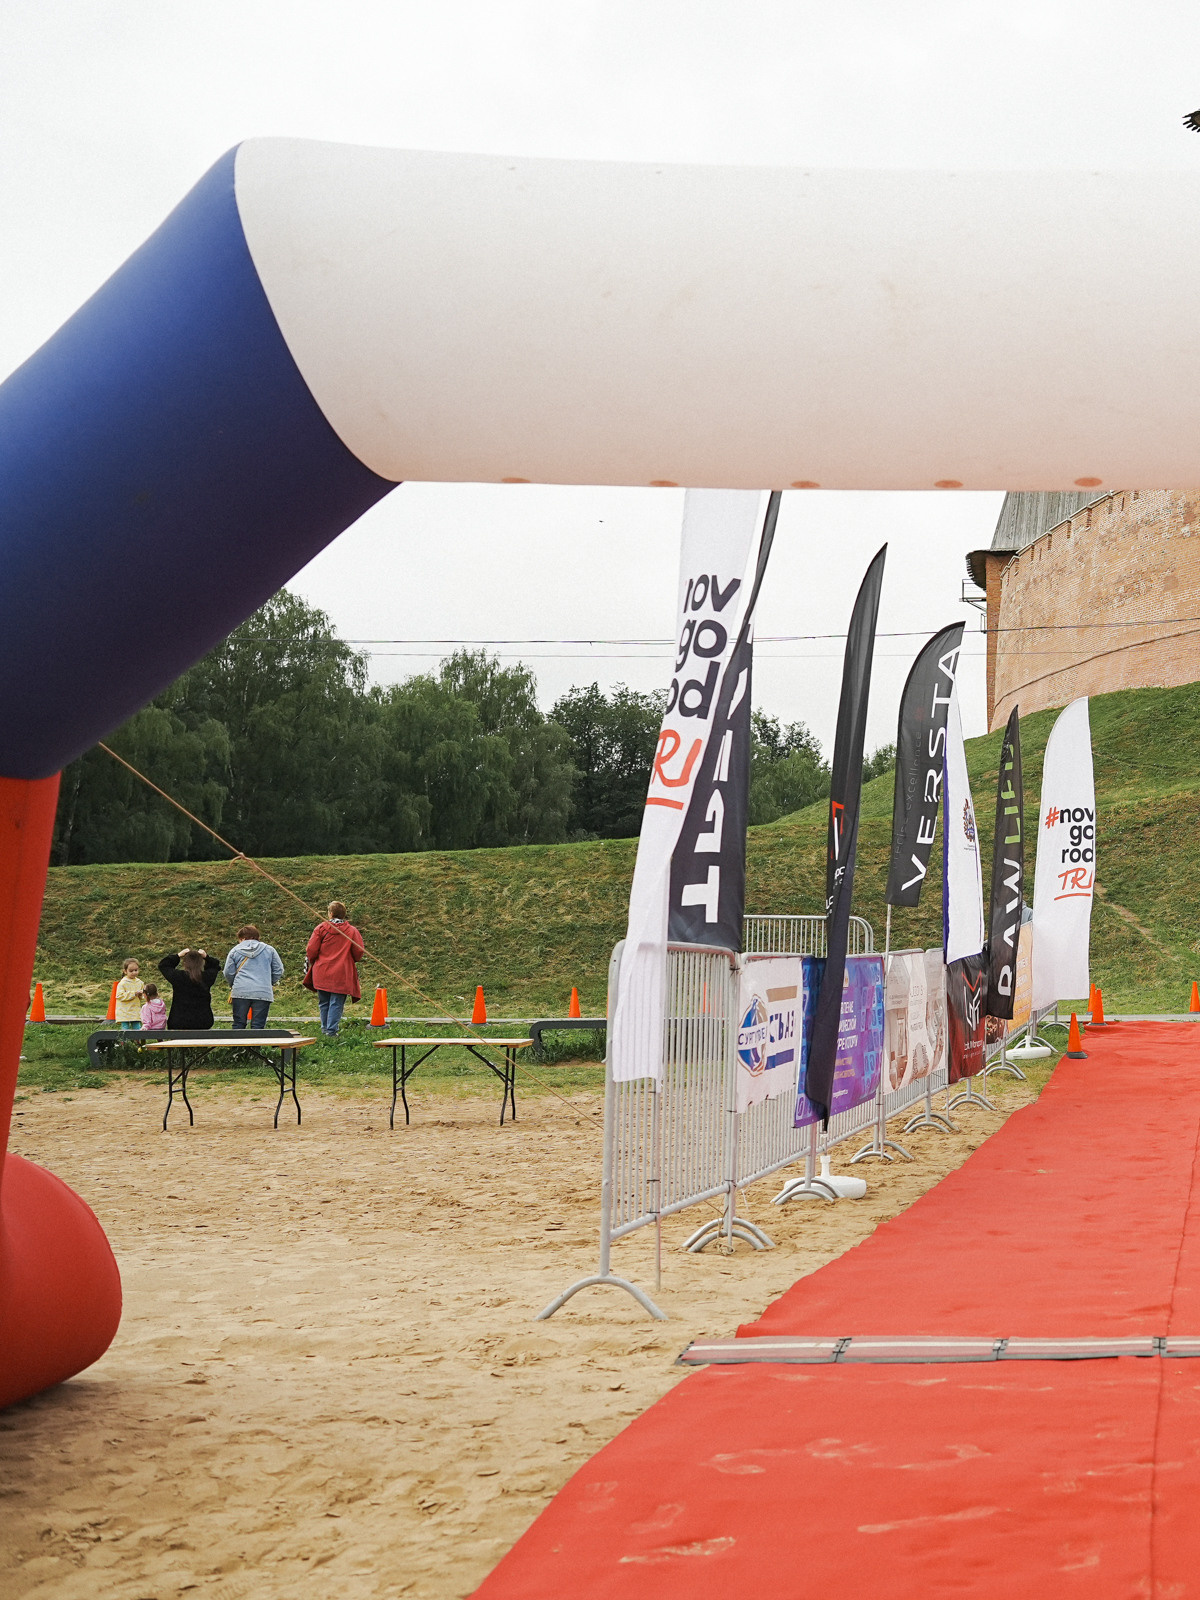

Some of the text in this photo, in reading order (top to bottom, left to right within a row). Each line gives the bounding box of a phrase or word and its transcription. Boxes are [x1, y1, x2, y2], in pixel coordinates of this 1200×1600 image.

[901, 644, 961, 891] VERSTA
[1044, 806, 1094, 829] #nov
[1069, 825, 1094, 846] go
